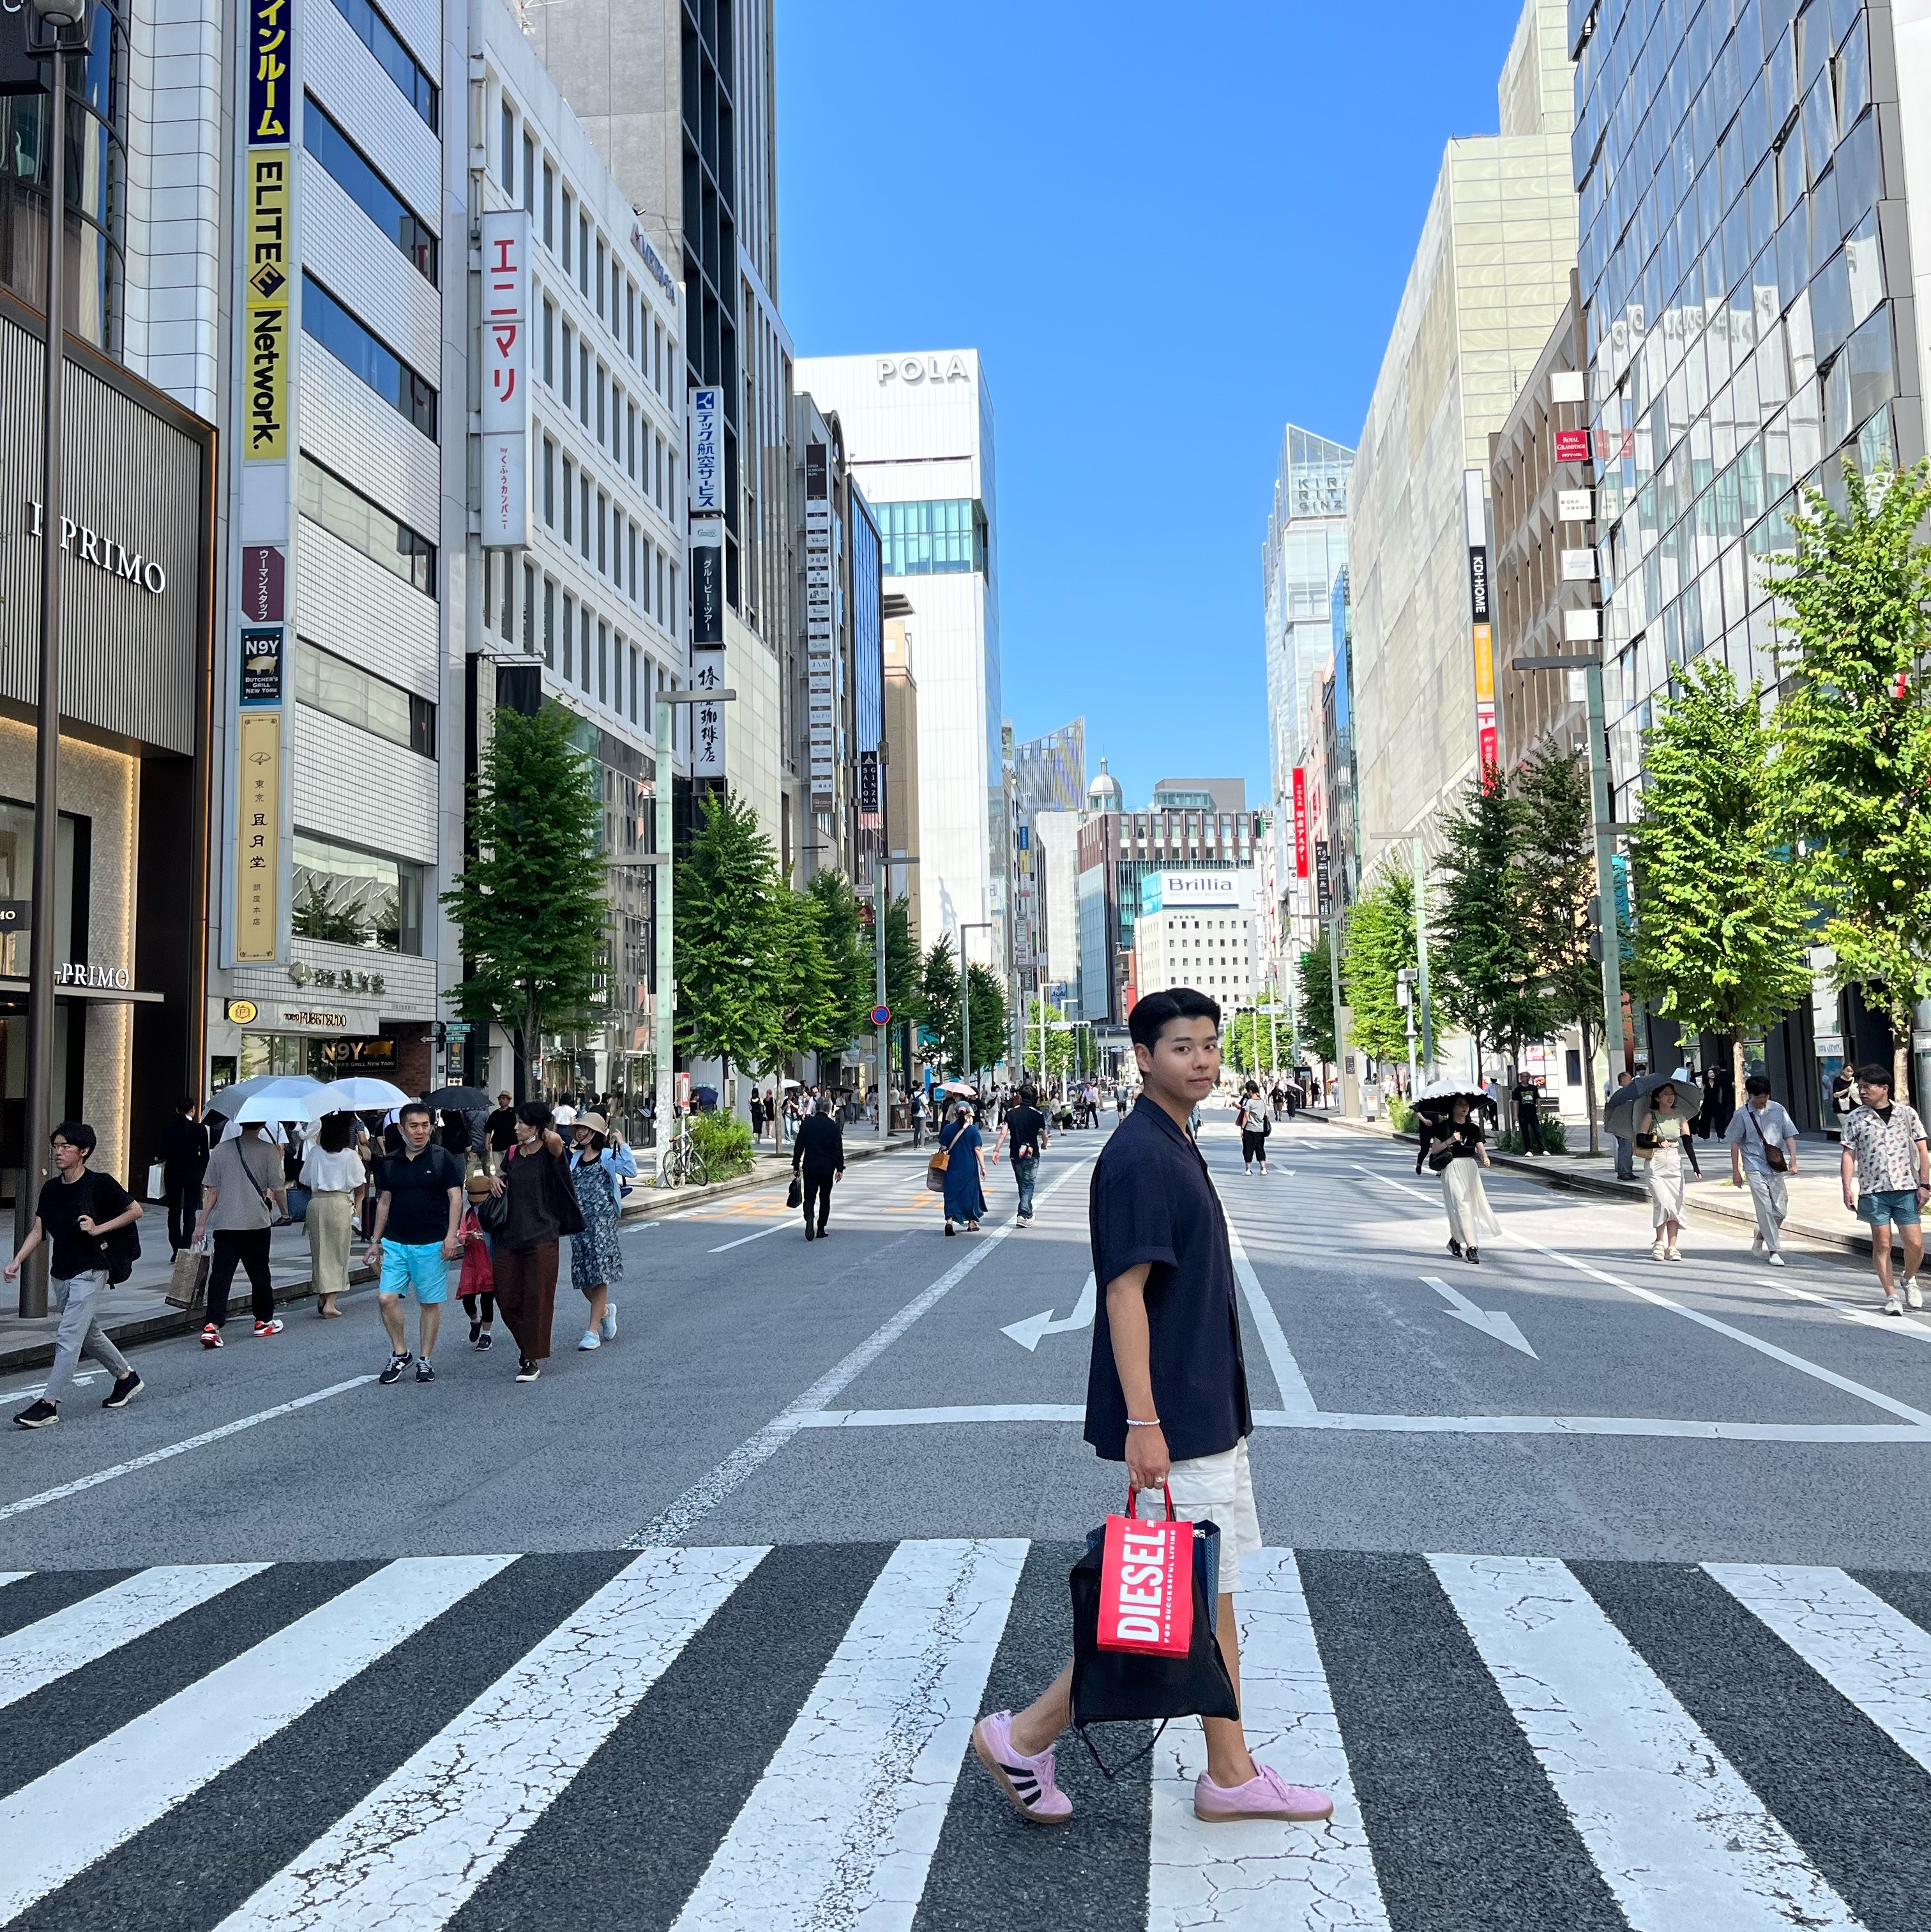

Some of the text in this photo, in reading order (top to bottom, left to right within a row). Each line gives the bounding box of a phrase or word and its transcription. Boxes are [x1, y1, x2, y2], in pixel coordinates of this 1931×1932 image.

[256, 0, 286, 137] インルーム
[255, 161, 283, 263] ELITE
[490, 239, 517, 403] エニマリ
[253, 310, 282, 450] Network.
[877, 355, 969, 383] POLA
[500, 455, 508, 530] くふうカンパニー
[697, 412, 715, 506] テック航空サービス
[60, 515, 166, 595] PRIMO
[259, 549, 269, 620] ウーマンスタッフ
[1473, 556, 1486, 614] KDI-HOME
[246, 640, 279, 655] N9Y
[1168, 878, 1232, 891] Brillia
[321, 1042, 364, 1061] N9Y
[1117, 1530, 1166, 1643] DIESEL
[1165, 1562, 1174, 1620] SUCCESSFUL
